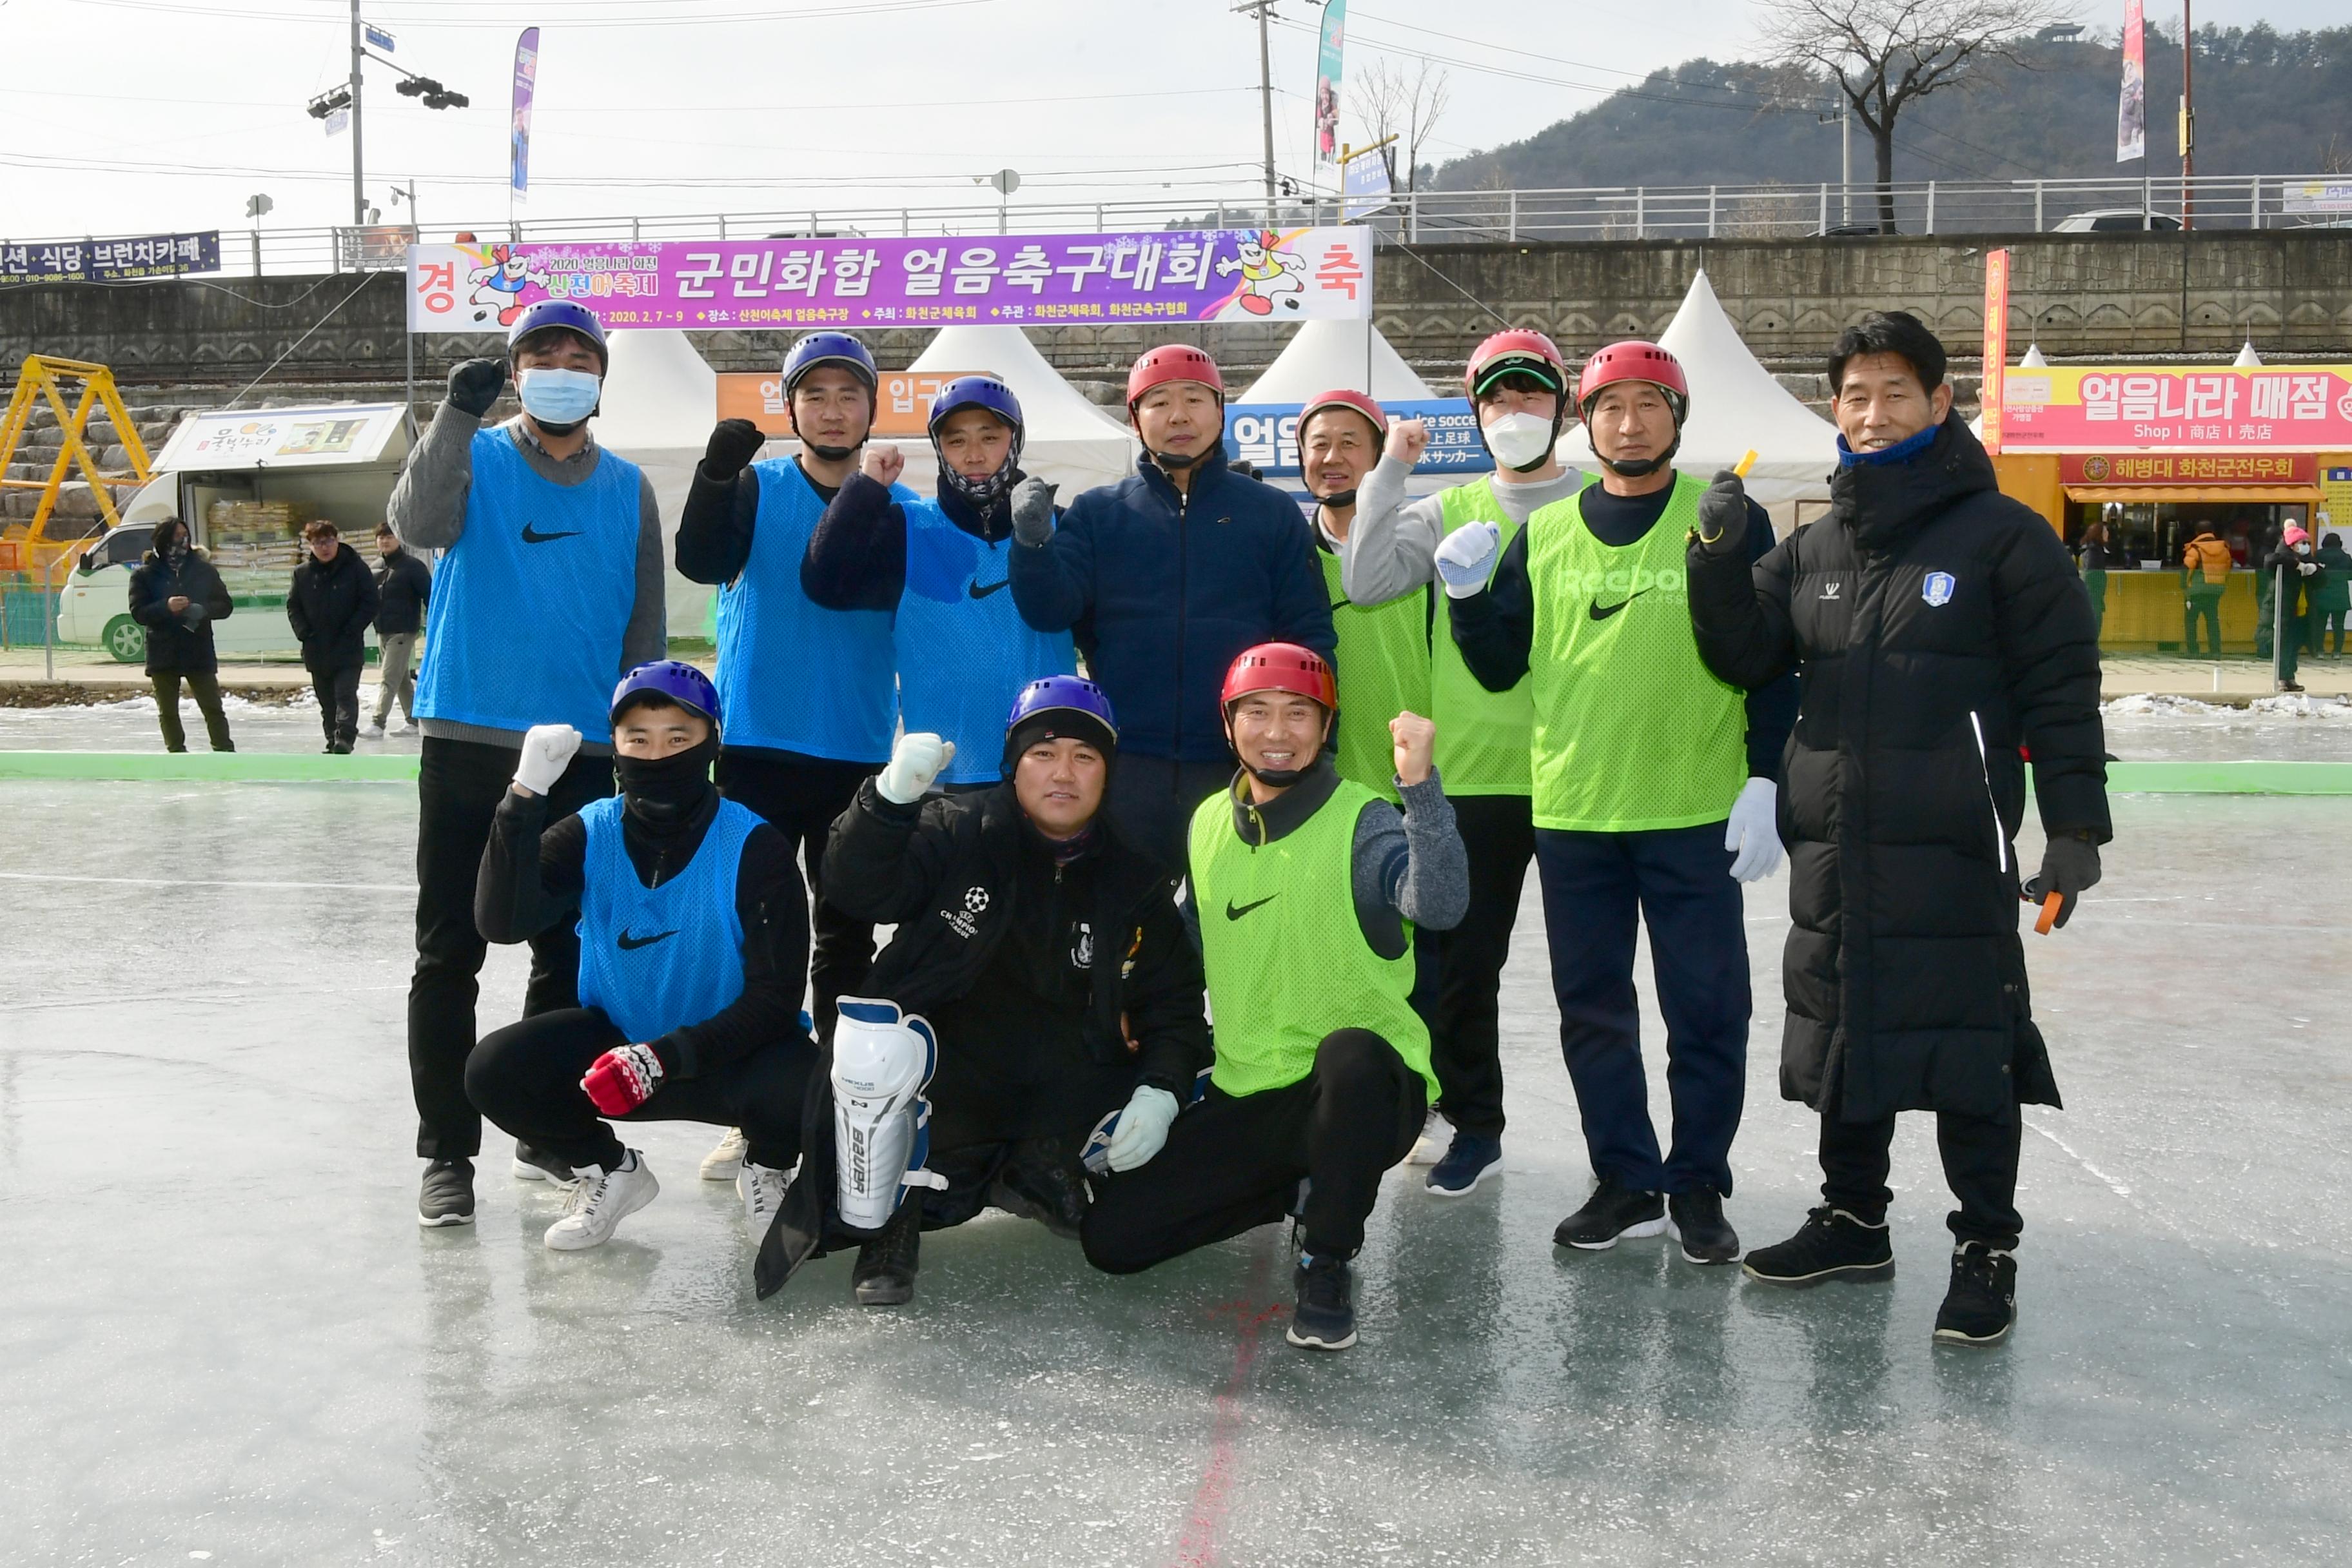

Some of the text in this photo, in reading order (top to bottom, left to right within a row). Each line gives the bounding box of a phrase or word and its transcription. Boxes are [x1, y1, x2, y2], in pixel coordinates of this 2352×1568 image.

[40, 246, 83, 272] 식당
[93, 237, 201, 268] 브런치카페
[550, 257, 658, 271] 2020 얼음나라 화천
[675, 242, 1215, 299] 군민화합 얼음축구대회
[1315, 244, 1363, 300] 축
[417, 261, 455, 314] 경
[547, 272, 659, 298] 산천어축제
[609, 311, 640, 322] 2020.
[643, 311, 652, 322] 2.
[656, 311, 663, 322] 7
[676, 310, 683, 322] 9
[707, 309, 730, 322] 장소
[739, 309, 792, 322] 산천어축제
[796, 308, 850, 321] 얼음축구장
[874, 307, 896, 320] 주최
[905, 304, 977, 320] 화천군체육회
[1002, 305, 1025, 319] 주관
[1034, 304, 1104, 318] 화천군체육회,
[1109, 302, 1188, 317] 화천군축구협회
[2082, 376, 2329, 421] 얼음나라 매점
[1438, 415, 1477, 427] socce
[1427, 431, 1471, 445] 上足球
[2134, 424, 2273, 441] Shop 商店 売店
[2115, 458, 2293, 478] 해병대 화천군전우회
[1556, 565, 1689, 599] Reebo
[940, 910, 979, 936] CHAMPIO
